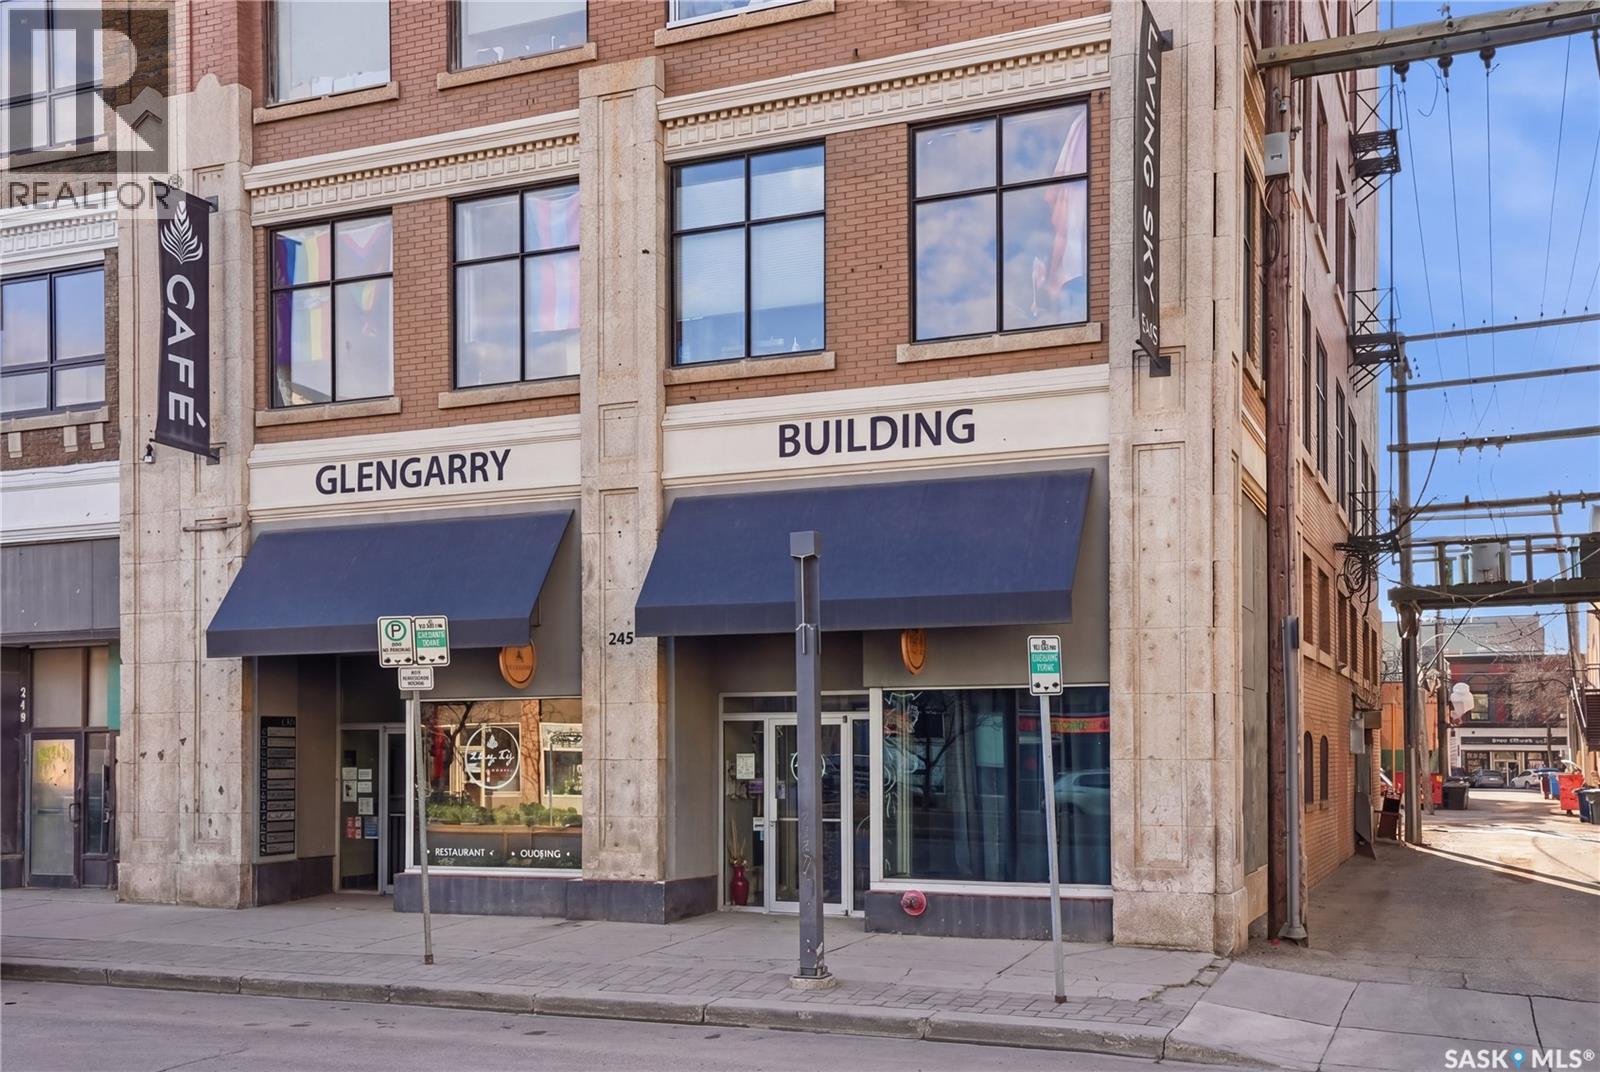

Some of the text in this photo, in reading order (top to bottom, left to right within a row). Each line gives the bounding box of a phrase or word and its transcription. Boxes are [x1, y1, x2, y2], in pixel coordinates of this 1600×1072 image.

[1143, 22, 1158, 189] LIVING
[1143, 204, 1155, 304] SKY
[166, 274, 207, 429] CAFÉ
[778, 408, 976, 459] BUILDING
[315, 448, 512, 496] GLENGARRY
[608, 631, 634, 646] 245
[434, 847, 486, 858] RESTAURANT
